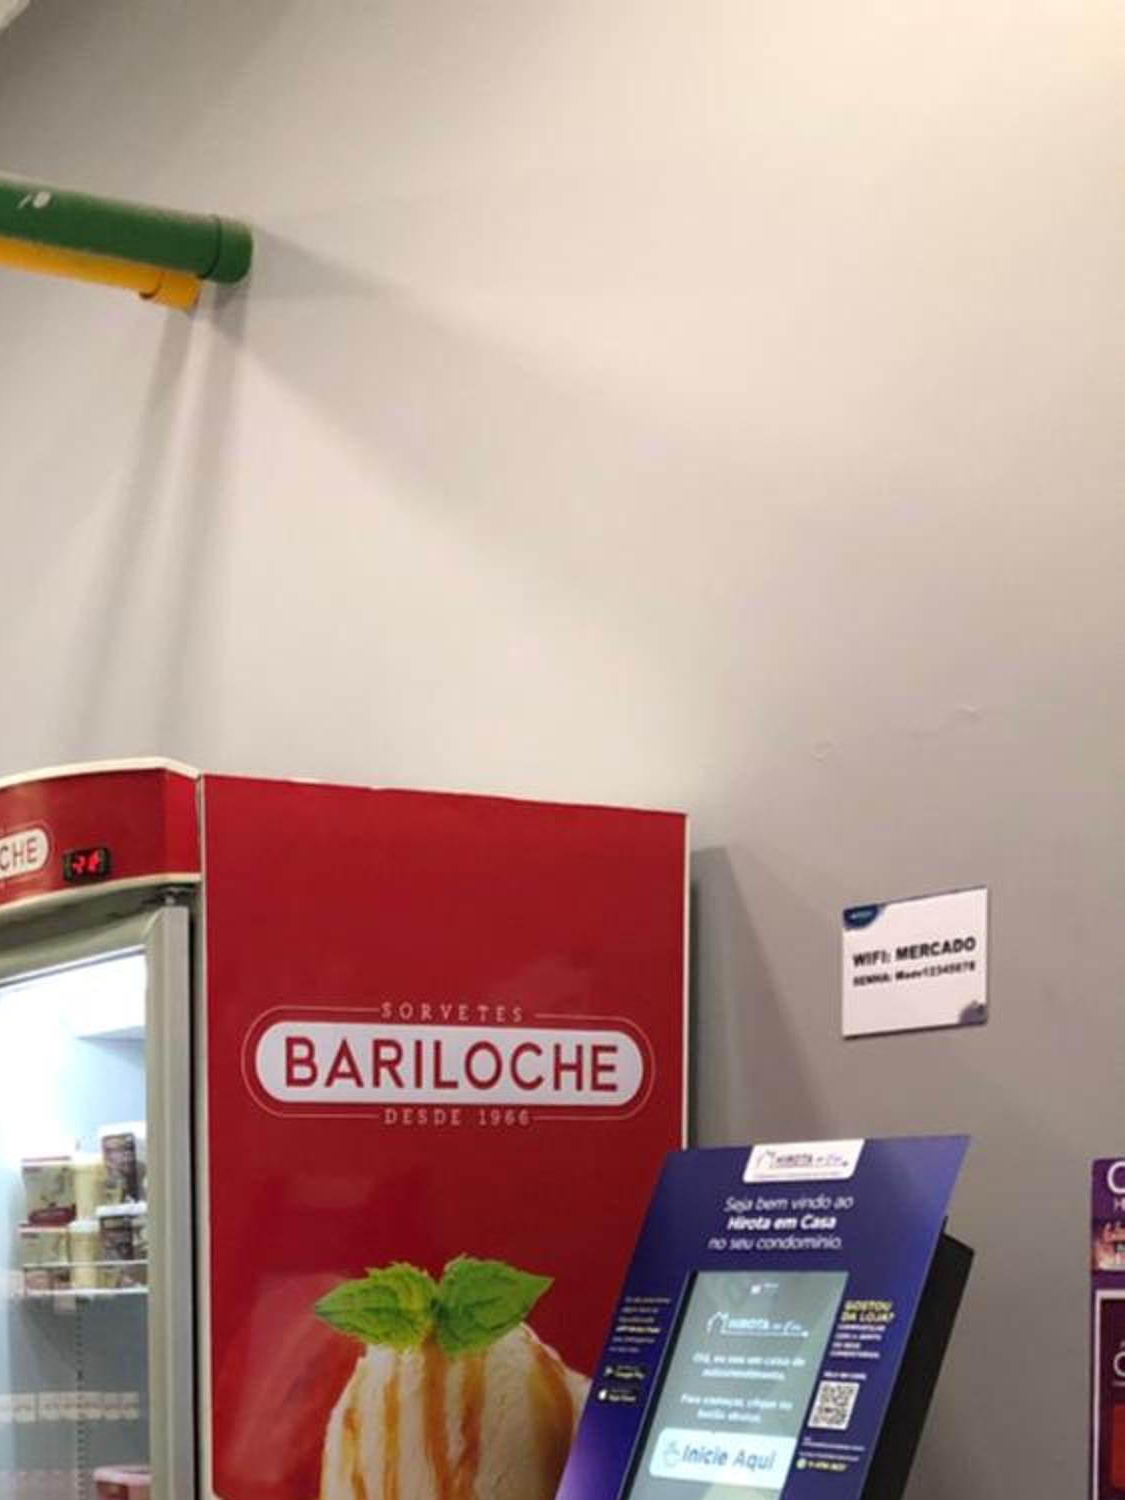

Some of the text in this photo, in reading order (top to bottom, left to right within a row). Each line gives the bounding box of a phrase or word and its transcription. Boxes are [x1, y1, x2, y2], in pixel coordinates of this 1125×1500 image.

[895, 936, 976, 961] MERCADO
[381, 1001, 524, 1023] SORVETES
[285, 1035, 618, 1093] BARILOCHE
[384, 1107, 531, 1127] DESDE 1966
[755, 1195, 788, 1211] bem
[791, 1193, 832, 1210] vindo
[833, 1196, 854, 1209] ao
[727, 1214, 837, 1231] Hirota em Casa
[708, 1236, 726, 1250] no
[729, 1237, 753, 1250] seu
[682, 1445, 728, 1466] Inicie
[732, 1449, 776, 1471] Aqui
